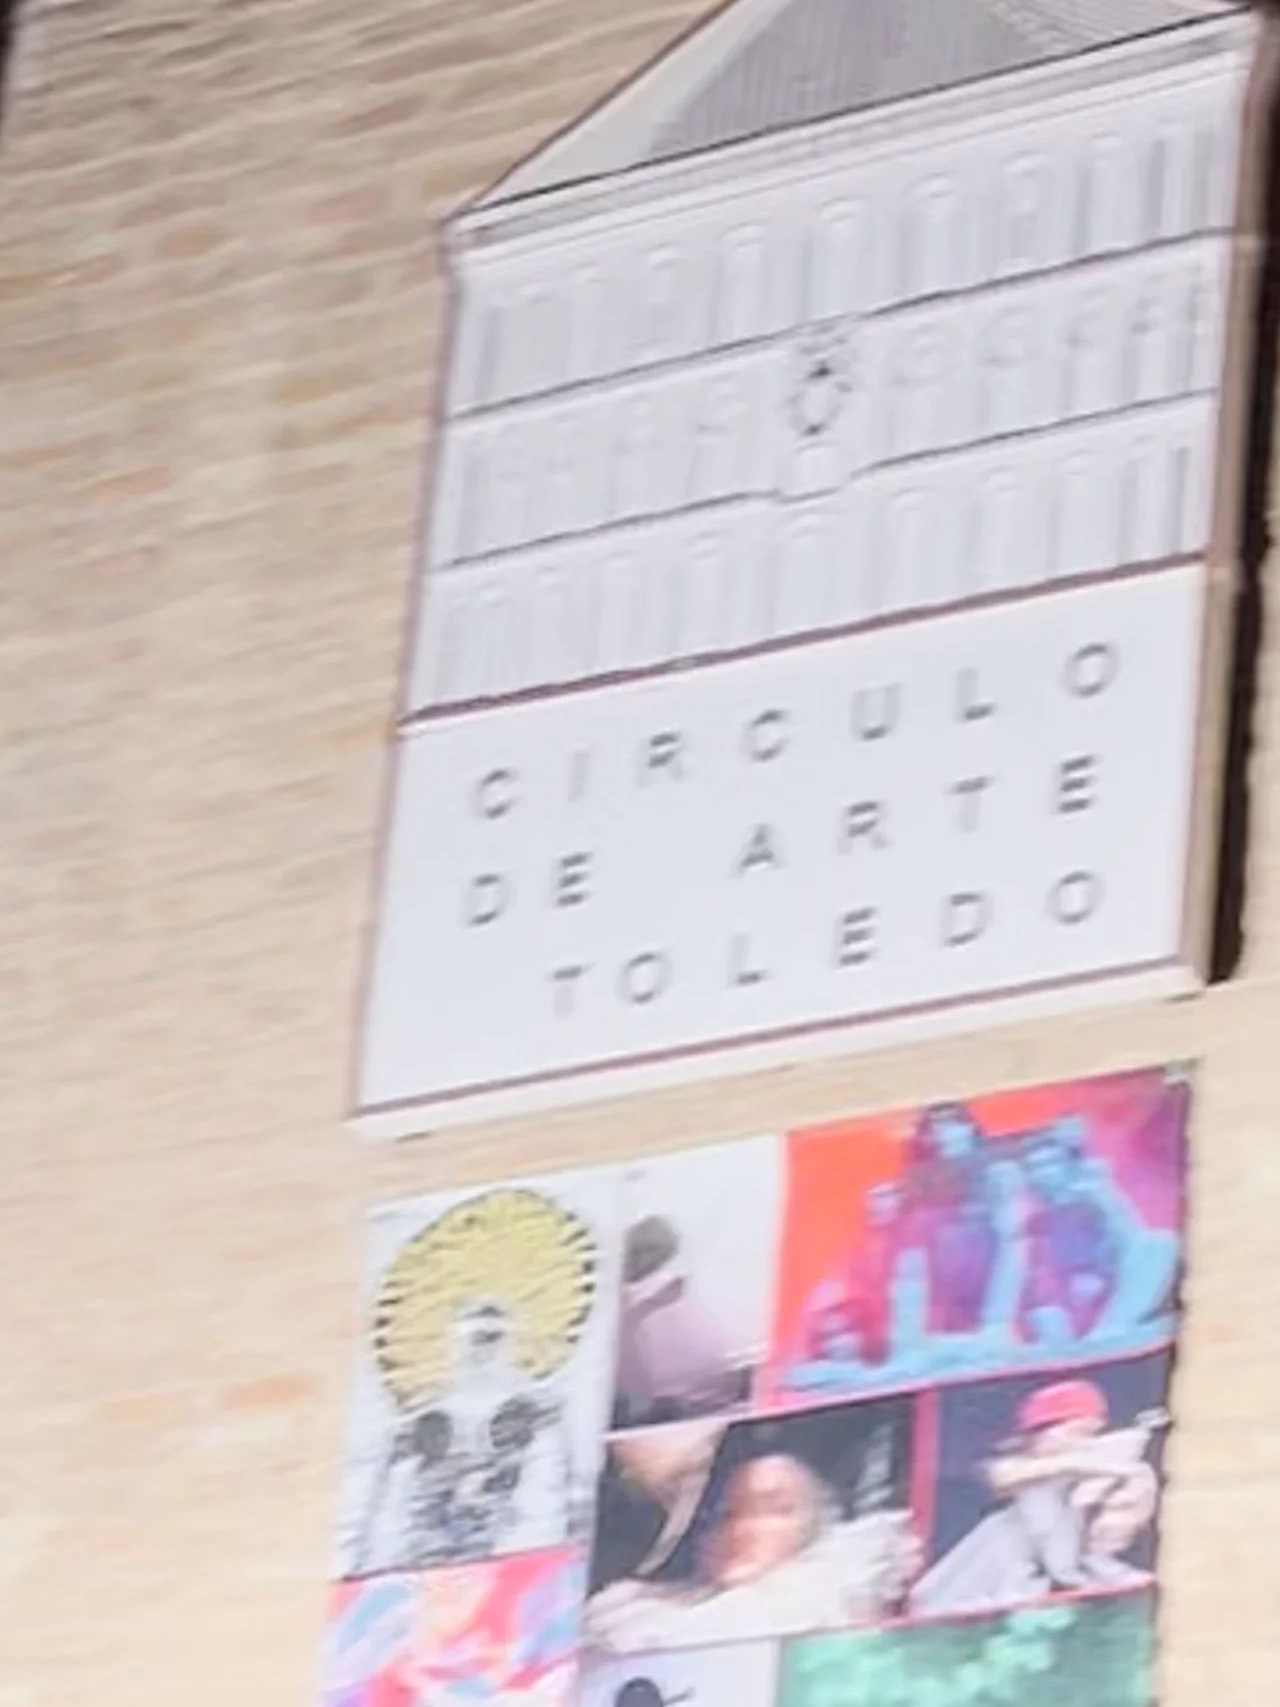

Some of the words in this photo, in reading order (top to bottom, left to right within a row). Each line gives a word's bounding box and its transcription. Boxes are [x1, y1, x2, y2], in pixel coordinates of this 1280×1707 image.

[472, 641, 1118, 823] CIRCULO
[462, 851, 594, 927] DE
[732, 753, 1101, 876] ARTE
[548, 868, 1104, 1019] TOLEDO
